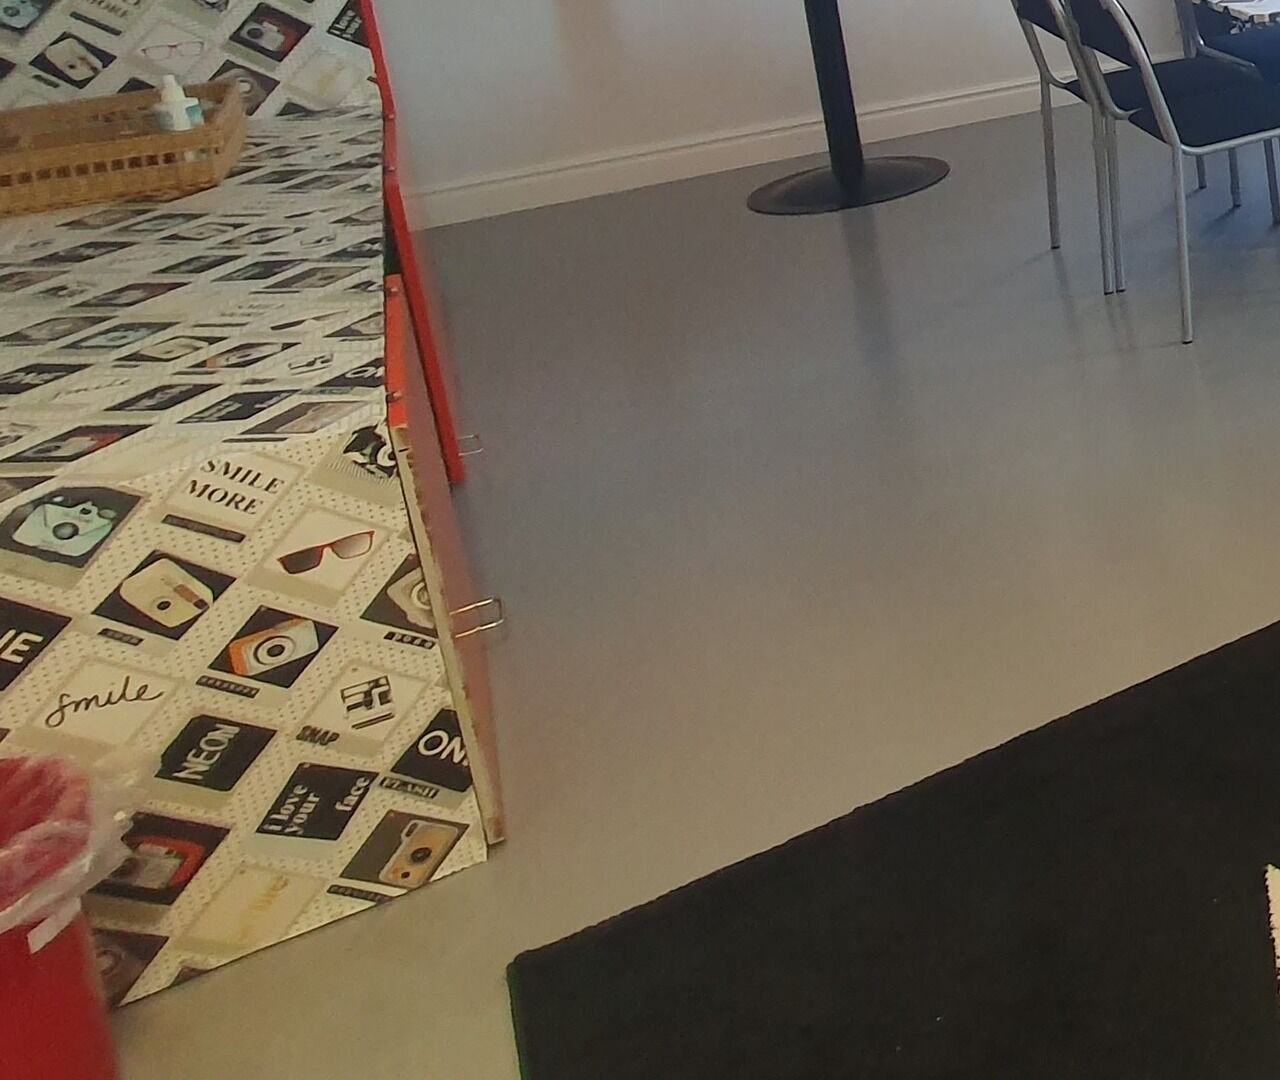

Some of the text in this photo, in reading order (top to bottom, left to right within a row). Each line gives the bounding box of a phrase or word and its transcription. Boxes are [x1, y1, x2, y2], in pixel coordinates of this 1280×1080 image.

[345, 366, 385, 378] ON
[201, 460, 285, 494] SMILE
[187, 479, 263, 515] MORE
[45, 675, 164, 728] smile
[172, 723, 241, 780] NEON
[418, 730, 468, 767] ON
[270, 784, 308, 821] love
[335, 777, 370, 811] face
[284, 793, 320, 835] your
